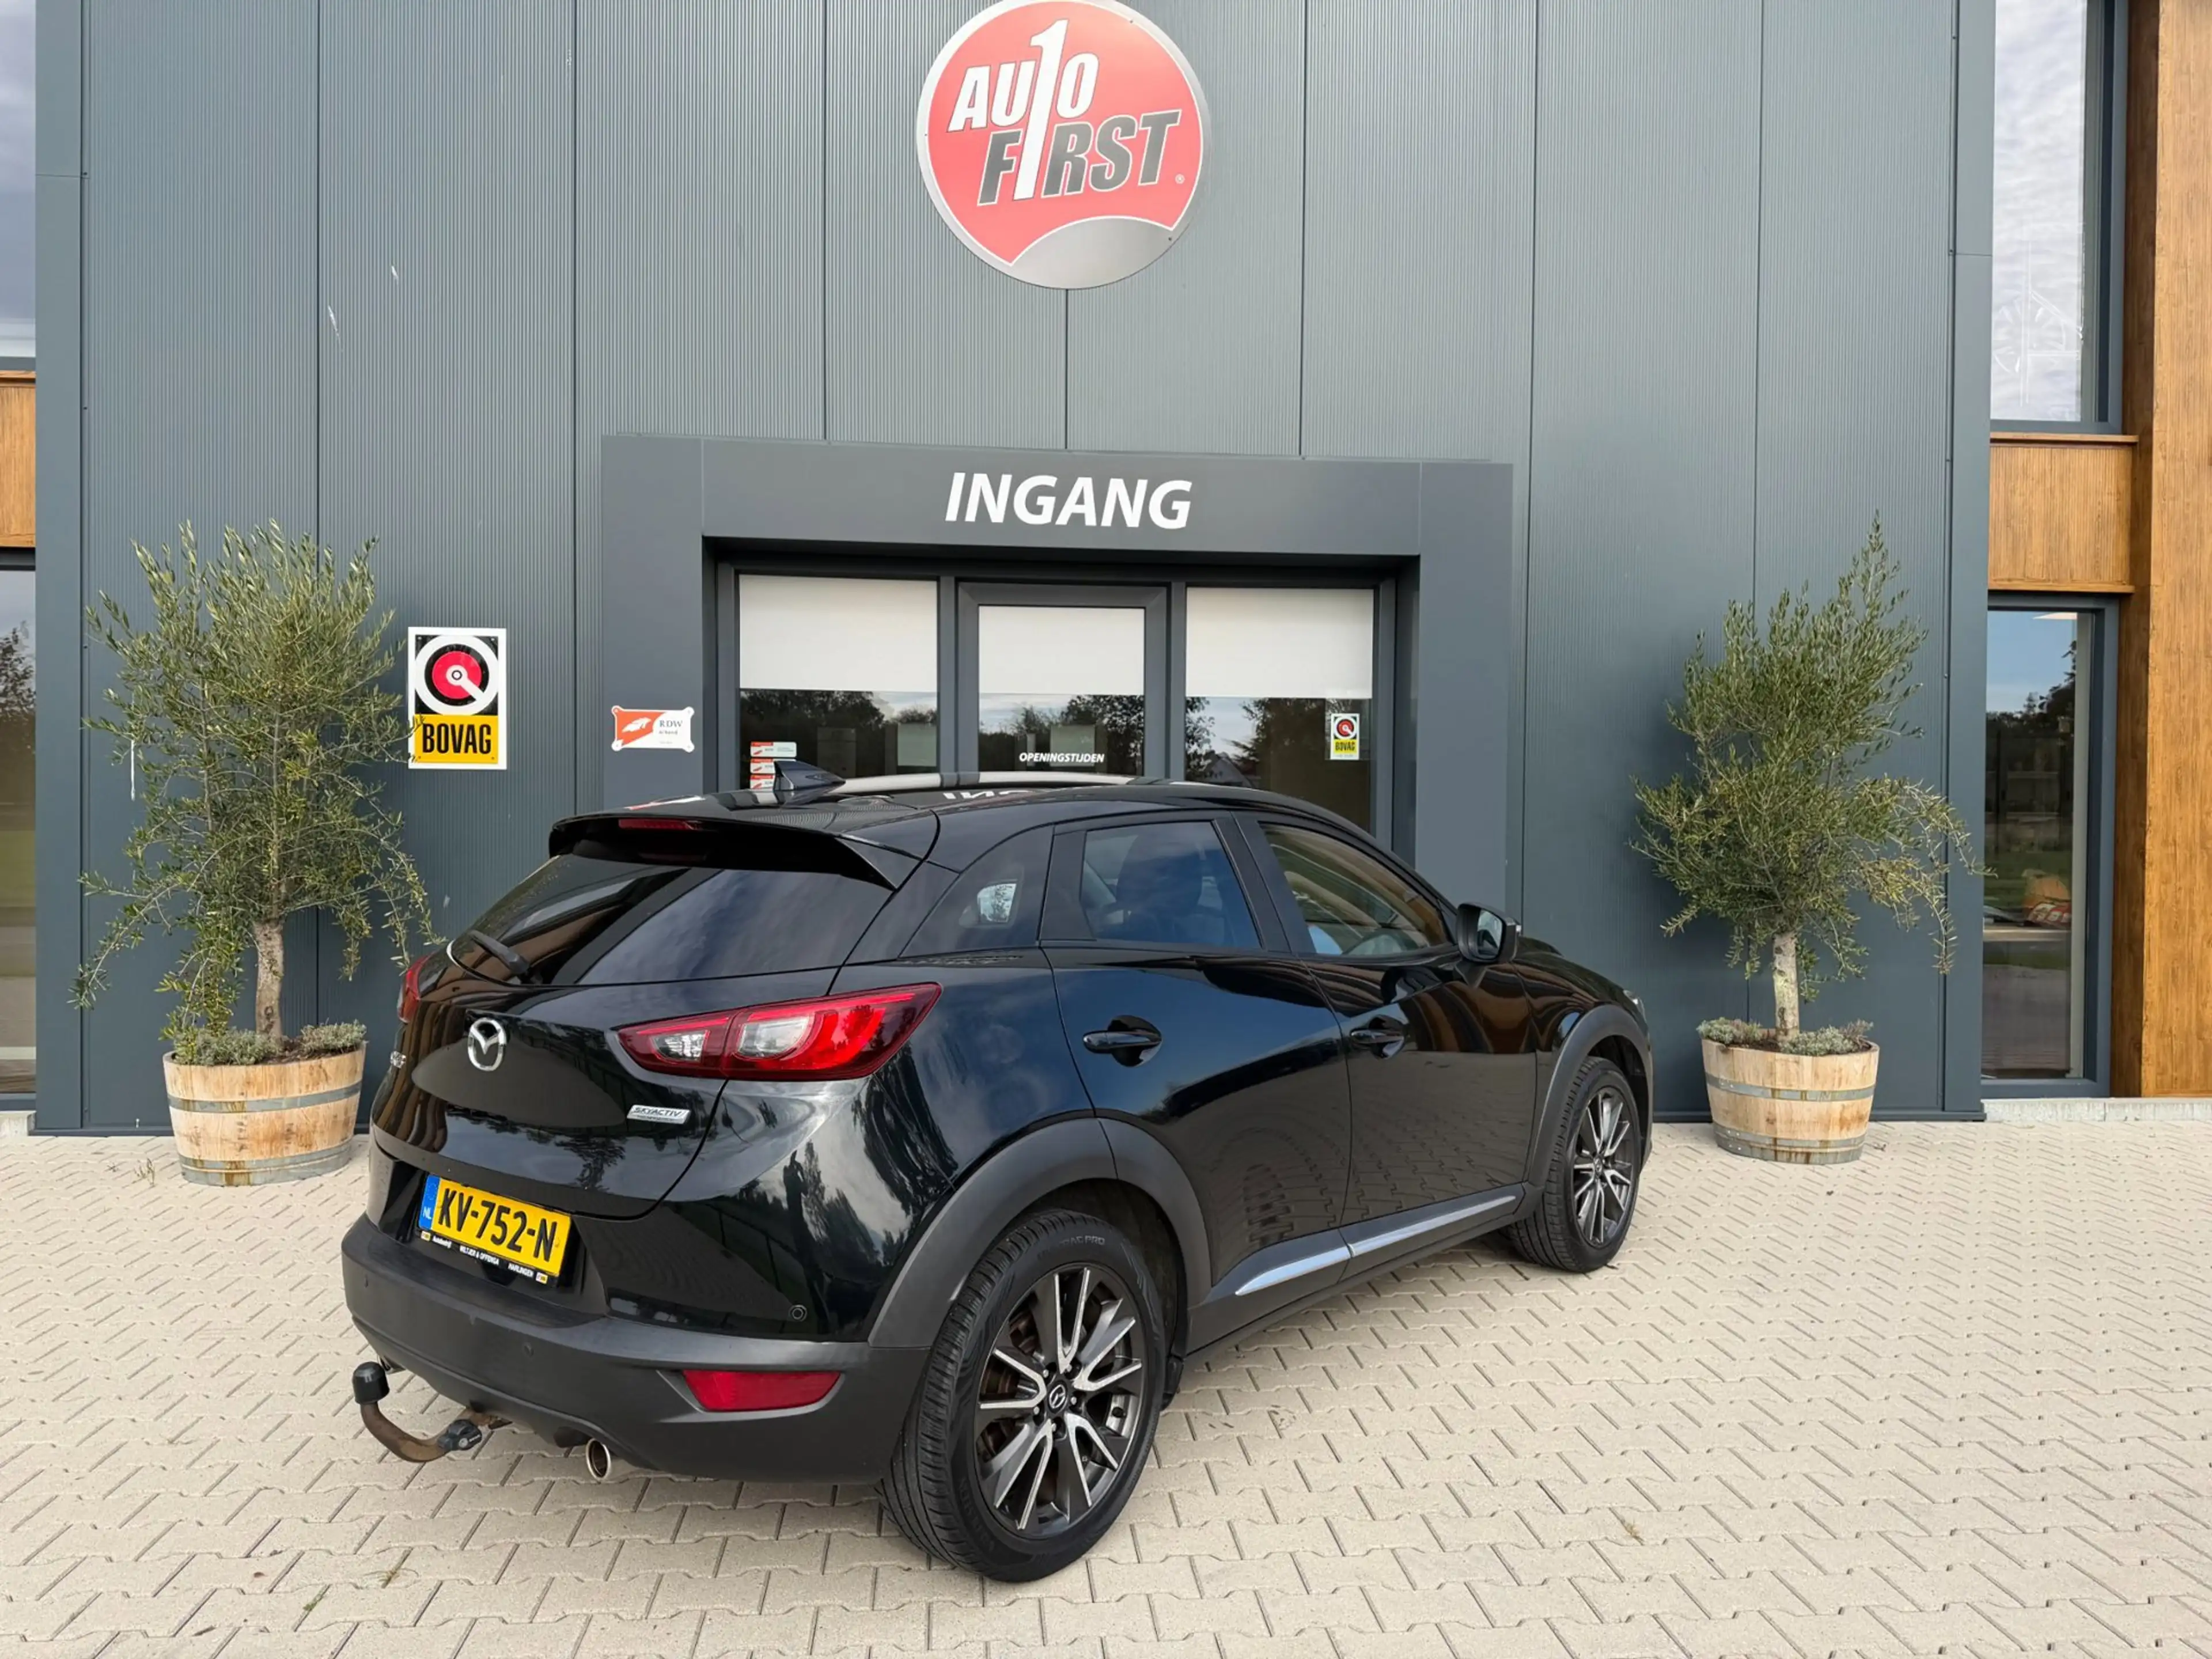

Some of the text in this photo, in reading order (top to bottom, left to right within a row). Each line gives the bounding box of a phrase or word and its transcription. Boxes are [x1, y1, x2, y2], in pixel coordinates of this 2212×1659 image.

[945, 472, 1192, 529] INGANG
[422, 723, 491, 754] BOVAG
[1335, 741, 1355, 751] BOVAG
[1019, 752, 1104, 763] OPENINGSTIJDEN
[634, 1107, 682, 1117] SKYACTIV
[423, 1206, 432, 1219] NL
[438, 1188, 558, 1262] KV-752-N
